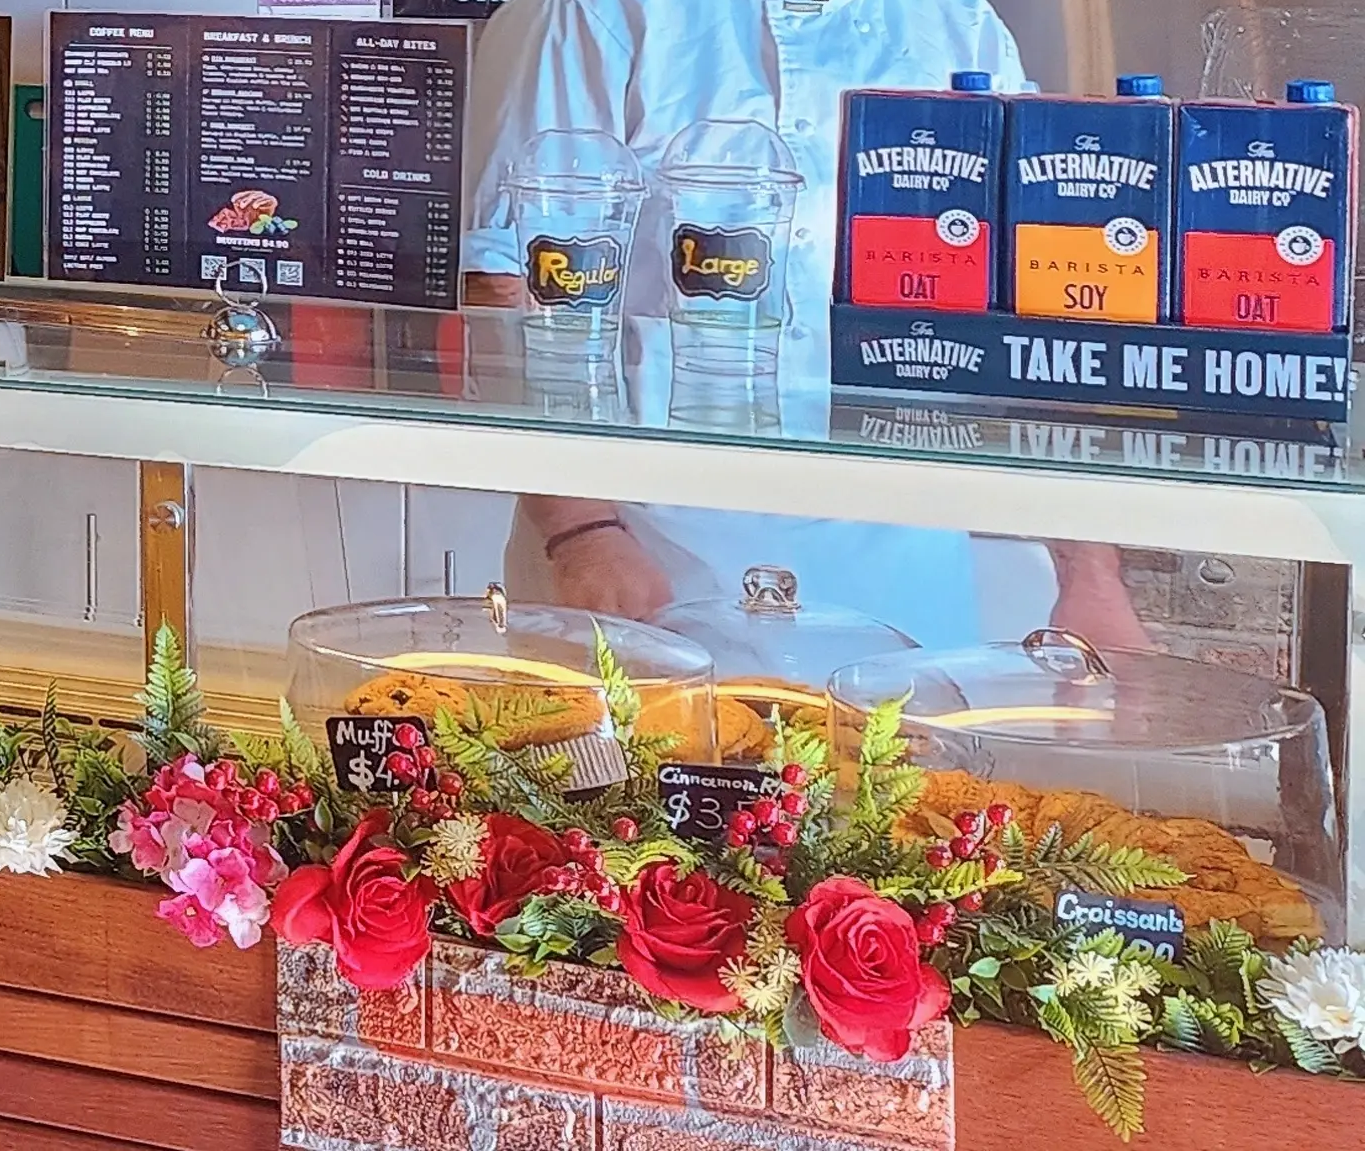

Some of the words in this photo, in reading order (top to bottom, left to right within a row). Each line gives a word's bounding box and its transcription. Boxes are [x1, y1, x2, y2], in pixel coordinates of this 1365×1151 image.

[856, 147, 989, 183] ALTERNATIVE
[1018, 153, 1158, 190] ALTERNATIVE
[1188, 160, 1334, 197] ALTERNATIVE
[892, 174, 930, 189] DAIRY
[1058, 182, 1096, 197] DAIRY
[1230, 189, 1269, 205] DAIRY
[682, 238, 760, 286] Large
[866, 250, 977, 266] BARISTA
[1030, 260, 1145, 276] BARISTA
[540, 252, 615, 295] Regula
[900, 273, 941, 299] OAT
[1198, 267, 1320, 286] BARISTA
[1064, 283, 1109, 310] SOY
[1237, 293, 1281, 322] OAT
[860, 338, 984, 373] ALTERNATIVE
[1003, 335, 1107, 386] TAKE
[1123, 345, 1188, 391] ME
[1205, 349, 1347, 402] HOME!
[895, 364, 930, 378] DAIRY
[336, 719, 425, 755] Muff
[659, 766, 758, 792] Cinnamon
